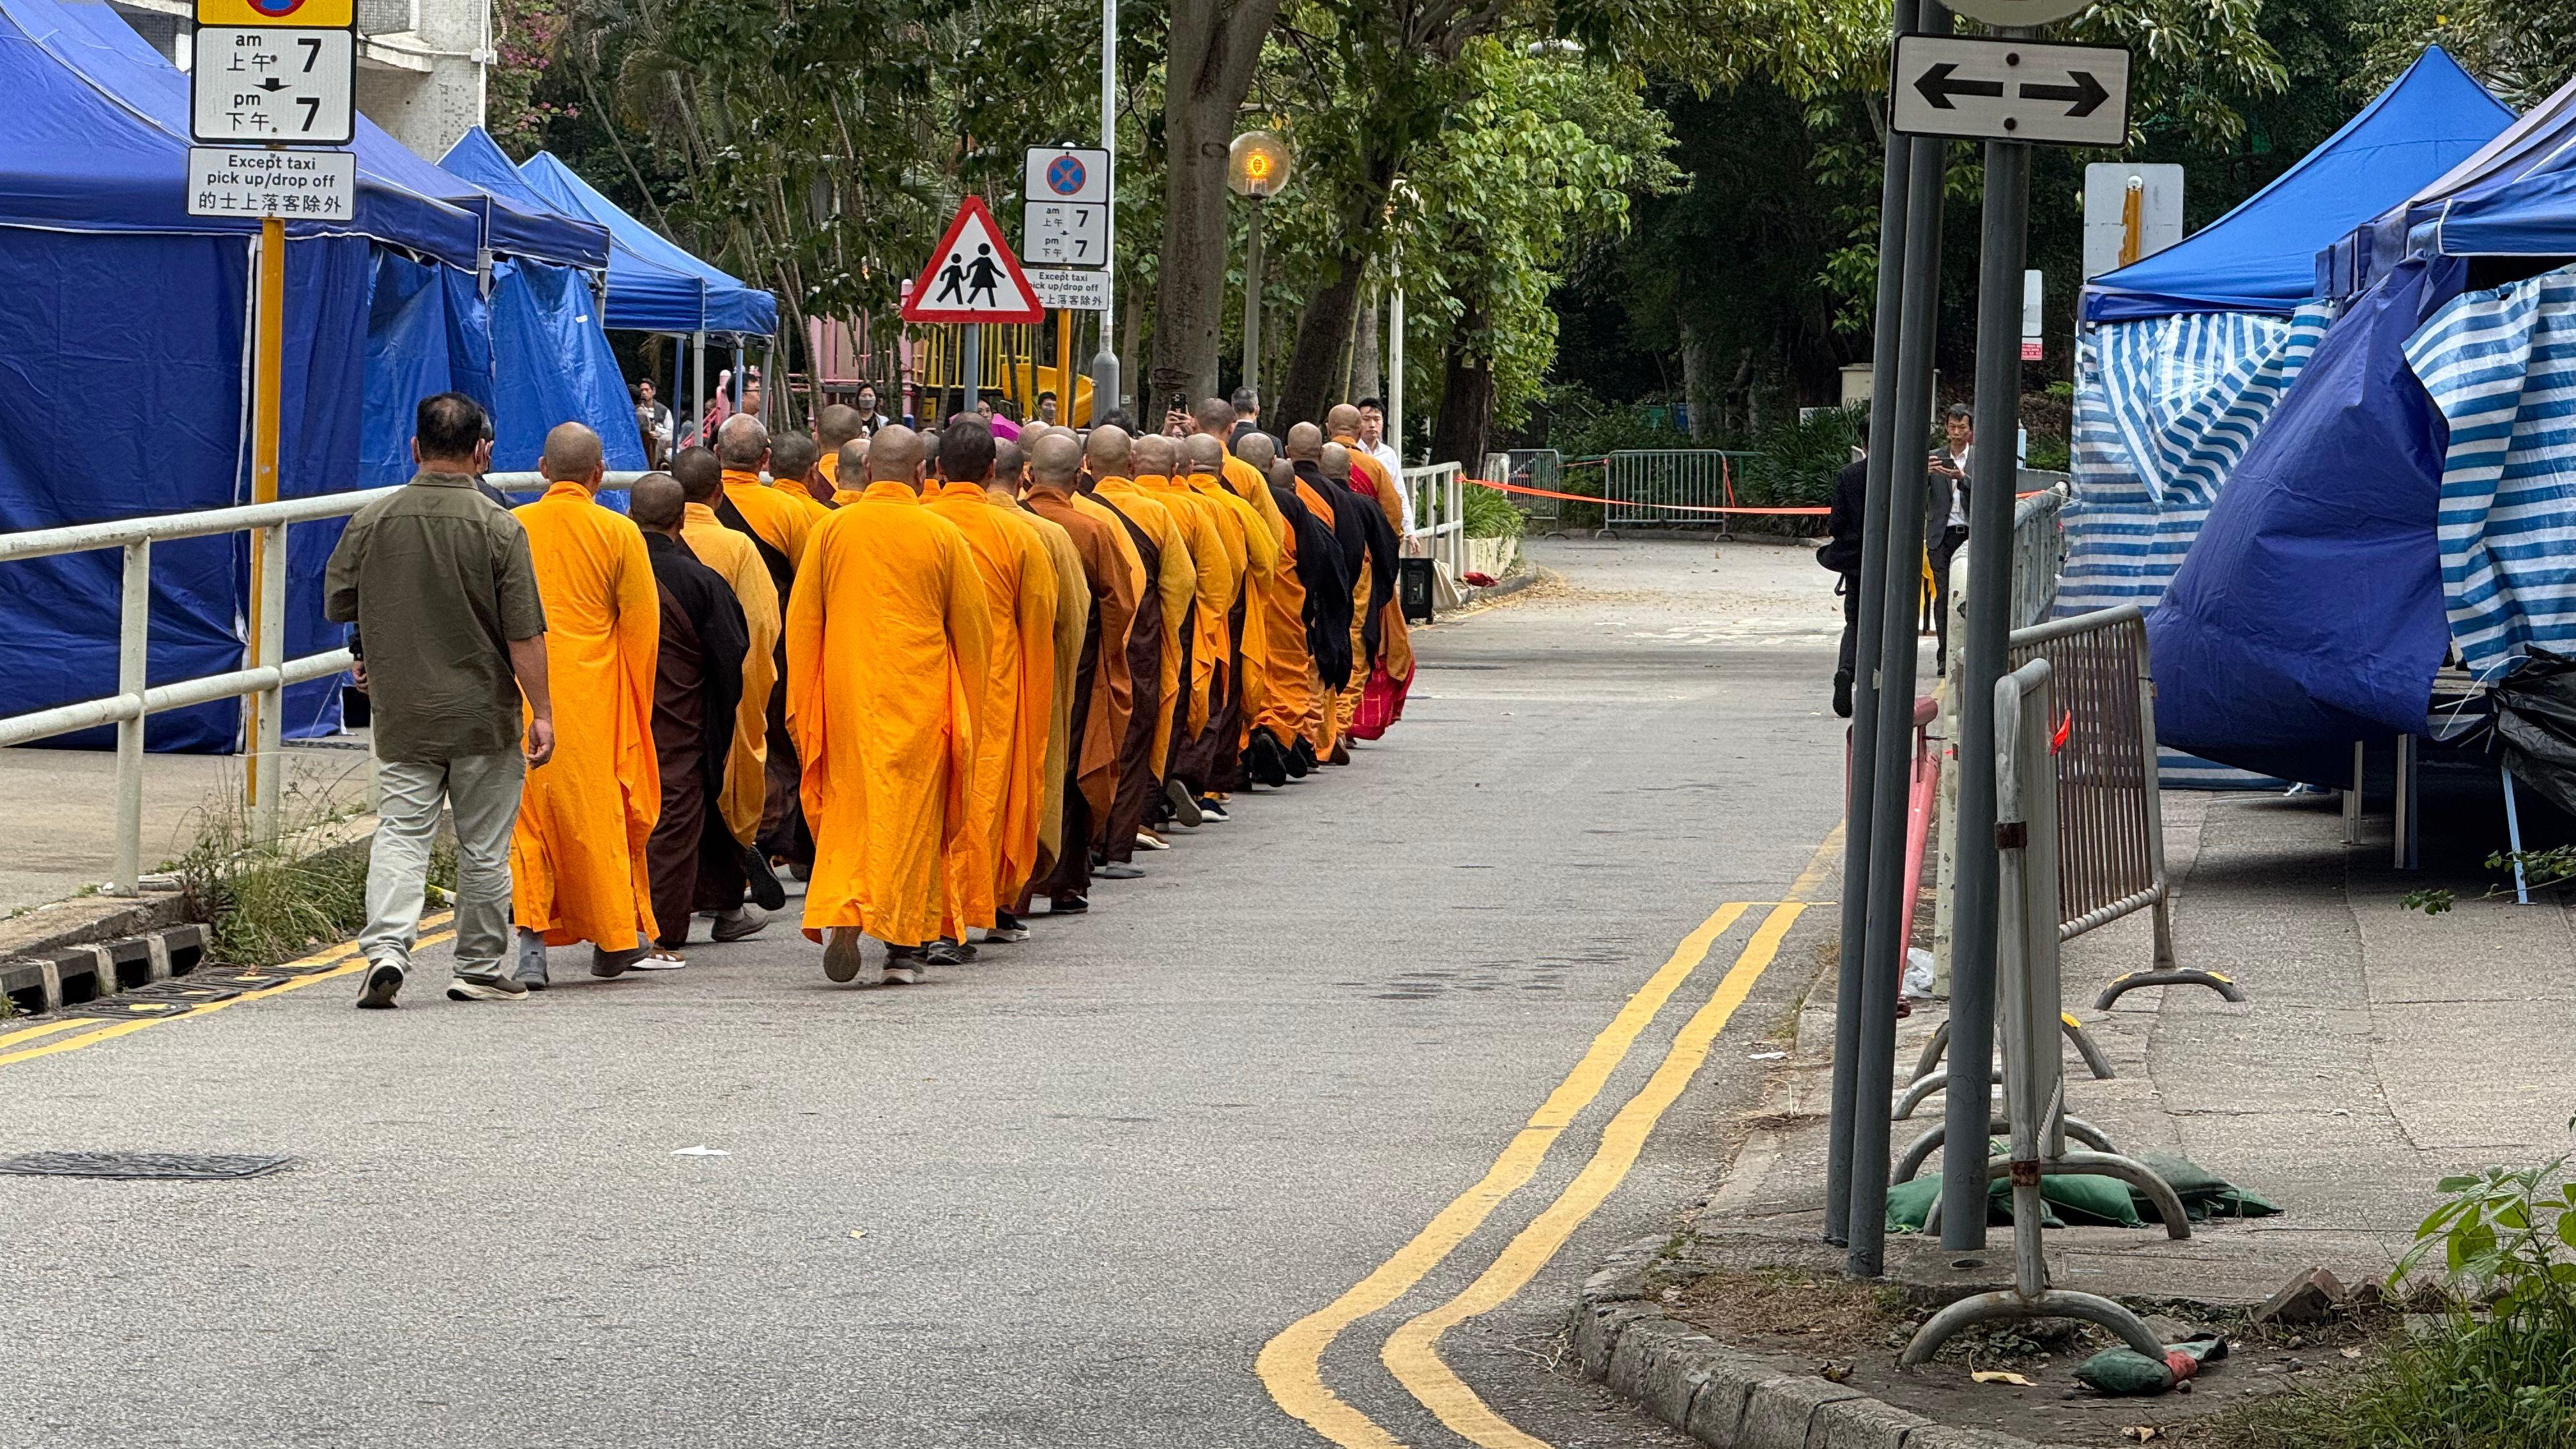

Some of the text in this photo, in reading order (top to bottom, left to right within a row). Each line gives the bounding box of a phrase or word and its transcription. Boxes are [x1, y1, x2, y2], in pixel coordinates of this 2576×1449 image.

[235, 34, 262, 47] am
[226, 52, 271, 73] 上午
[297, 38, 321, 73] 7
[234, 94, 261, 109] pm
[226, 112, 270, 132] 下午
[296, 97, 320, 132] 7
[229, 155, 316, 171] Except taxi
[207, 171, 335, 188] pick up/drop off
[199, 192, 342, 213] 的士上落客除外
[1042, 218, 1063, 227] 上午
[1076, 210, 1089, 227] 7
[1041, 248, 1061, 257] 下午
[1075, 240, 1087, 257] 7
[1039, 272, 1069, 282] Except
[1048, 283, 1083, 292] up/drop
